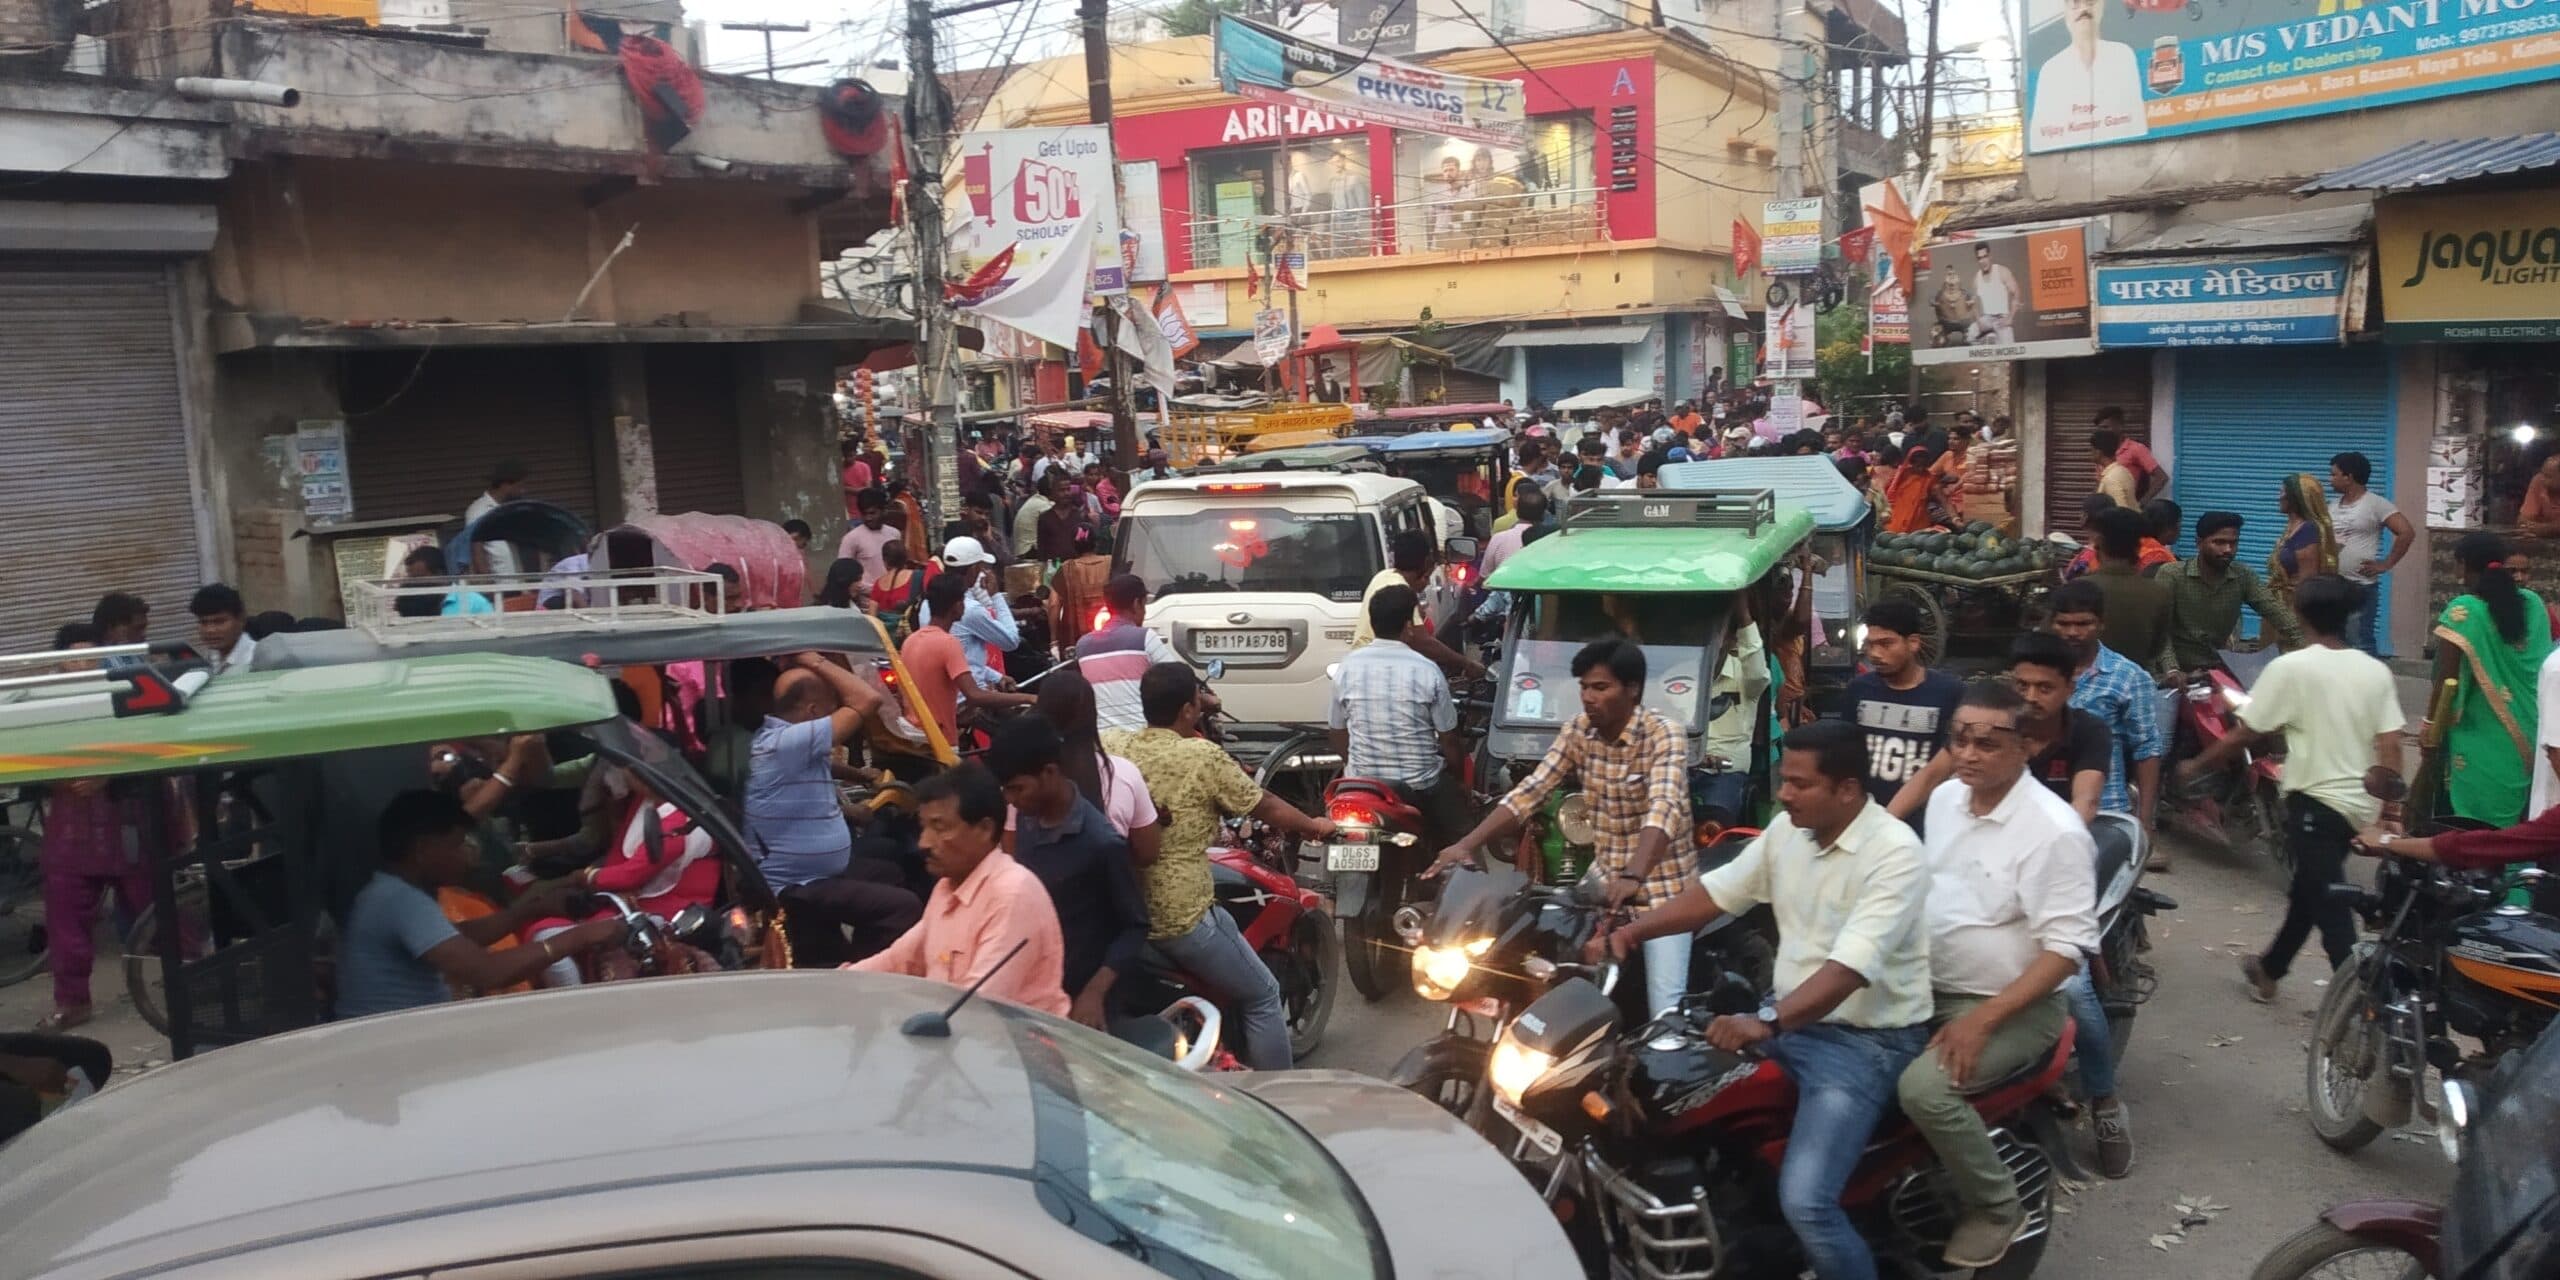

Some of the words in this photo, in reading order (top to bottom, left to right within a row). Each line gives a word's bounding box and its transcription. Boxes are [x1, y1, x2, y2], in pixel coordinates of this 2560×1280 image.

[1347, 23, 1411, 43] JOCKEY
[2200, 31, 2267, 67] M/S
[2276, 0, 2442, 51] VEDANT
[2415, 34, 2456, 51] Mob:
[2203, 64, 2264, 86] Contact
[2267, 59, 2290, 75] for
[2293, 44, 2384, 72] Dealership
[2418, 55, 2459, 75] Naya
[2463, 49, 2498, 67] Tola
[1611, 67, 1636, 96] A
[1357, 75, 1464, 115] PHYSICS
[1038, 140, 1063, 157] Get
[1065, 139, 1098, 158] Upto
[1022, 160, 1080, 223] 50%
[1766, 199, 1818, 212] CONCEPT
[2109, 278, 2195, 301] पारस
[2201, 267, 2338, 297] मेडिकल
[2444, 328, 2487, 338] ROSHNI
[2489, 326, 2546, 338] ELECTRIC
[1968, 348, 1995, 359] INNER
[1997, 345, 2026, 357] WORLD
[1342, 847, 1371, 858] DL6S
